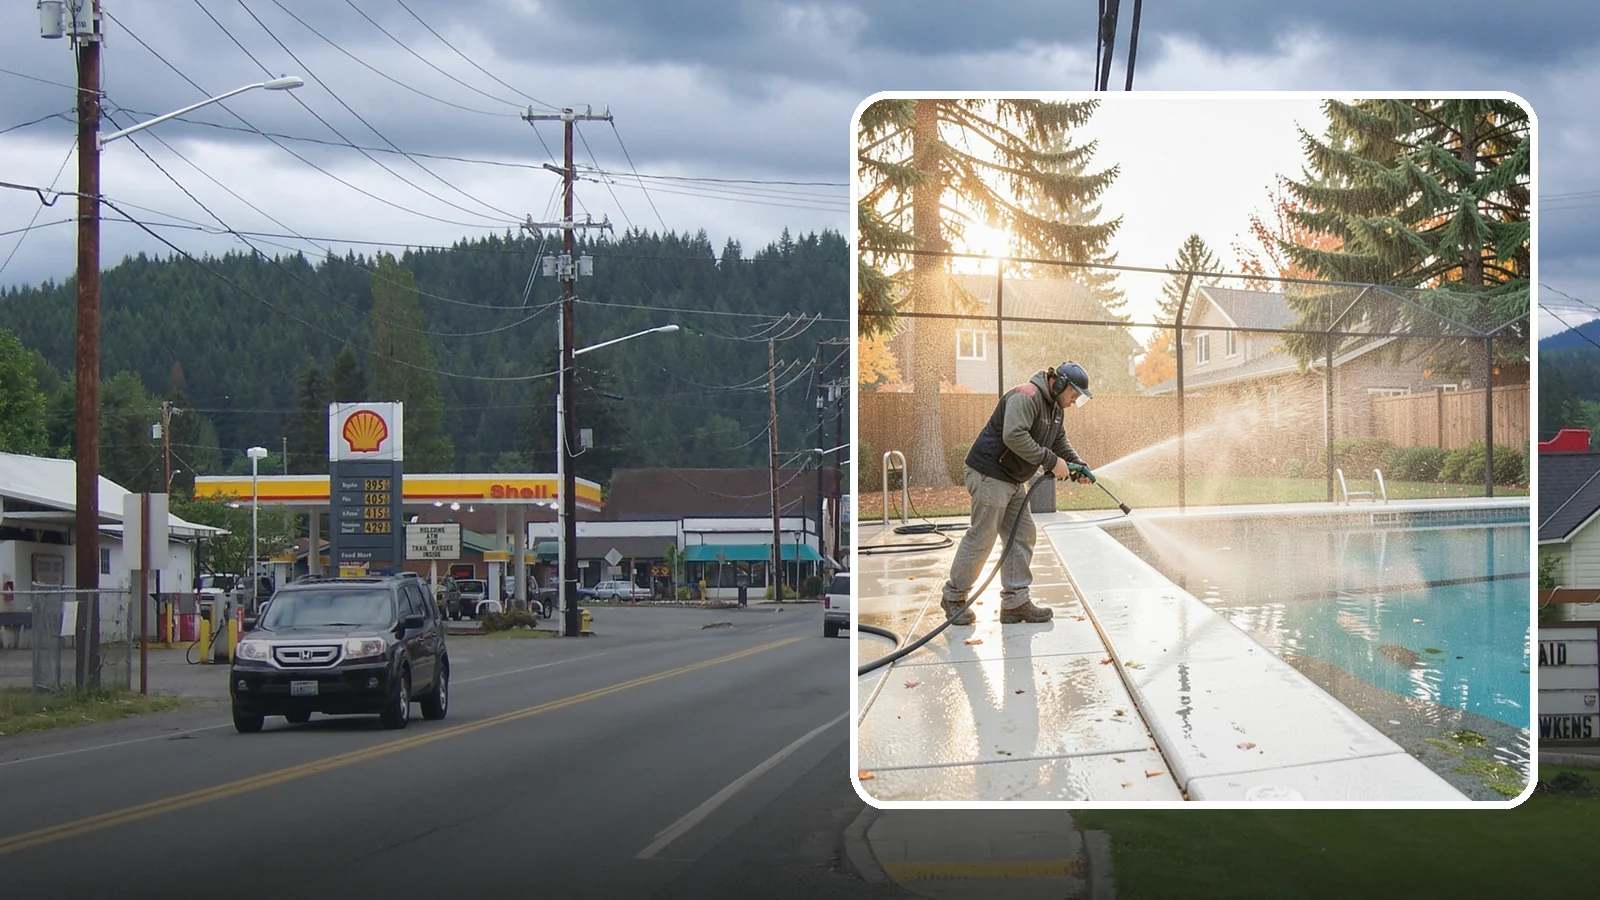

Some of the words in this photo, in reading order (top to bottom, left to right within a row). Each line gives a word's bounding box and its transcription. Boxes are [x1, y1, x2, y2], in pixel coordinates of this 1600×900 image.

[365, 480, 384, 490] 395
[490, 484, 547, 499] Shell
[365, 494, 384, 504] 405
[365, 508, 384, 518] 415
[365, 522, 384, 533] 429
[1538, 643, 1567, 665] AID
